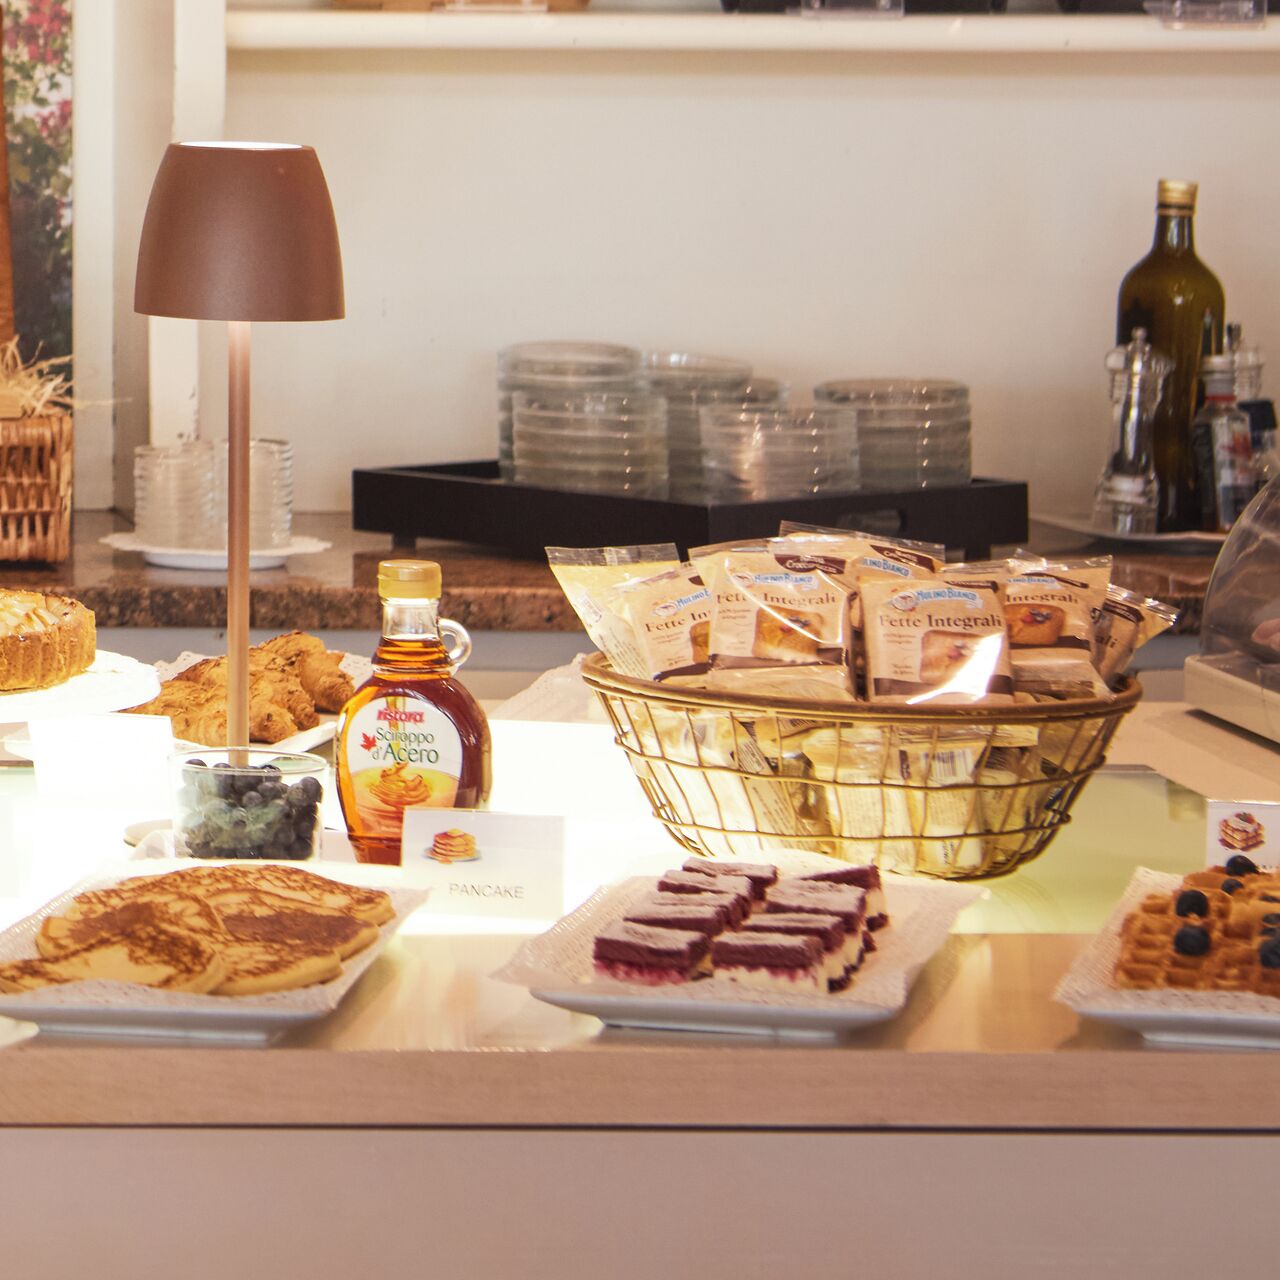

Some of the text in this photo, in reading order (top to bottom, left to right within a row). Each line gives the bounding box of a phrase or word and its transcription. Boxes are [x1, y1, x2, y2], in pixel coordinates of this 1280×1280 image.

[763, 592, 836, 607] Integrali
[645, 617, 686, 633] Fette
[879, 614, 1002, 630] Fette Integrali
[378, 707, 425, 724] ristora
[376, 727, 435, 749] Sciroppo
[372, 742, 439, 764] d'Acero
[448, 882, 525, 899] PANCAKE
